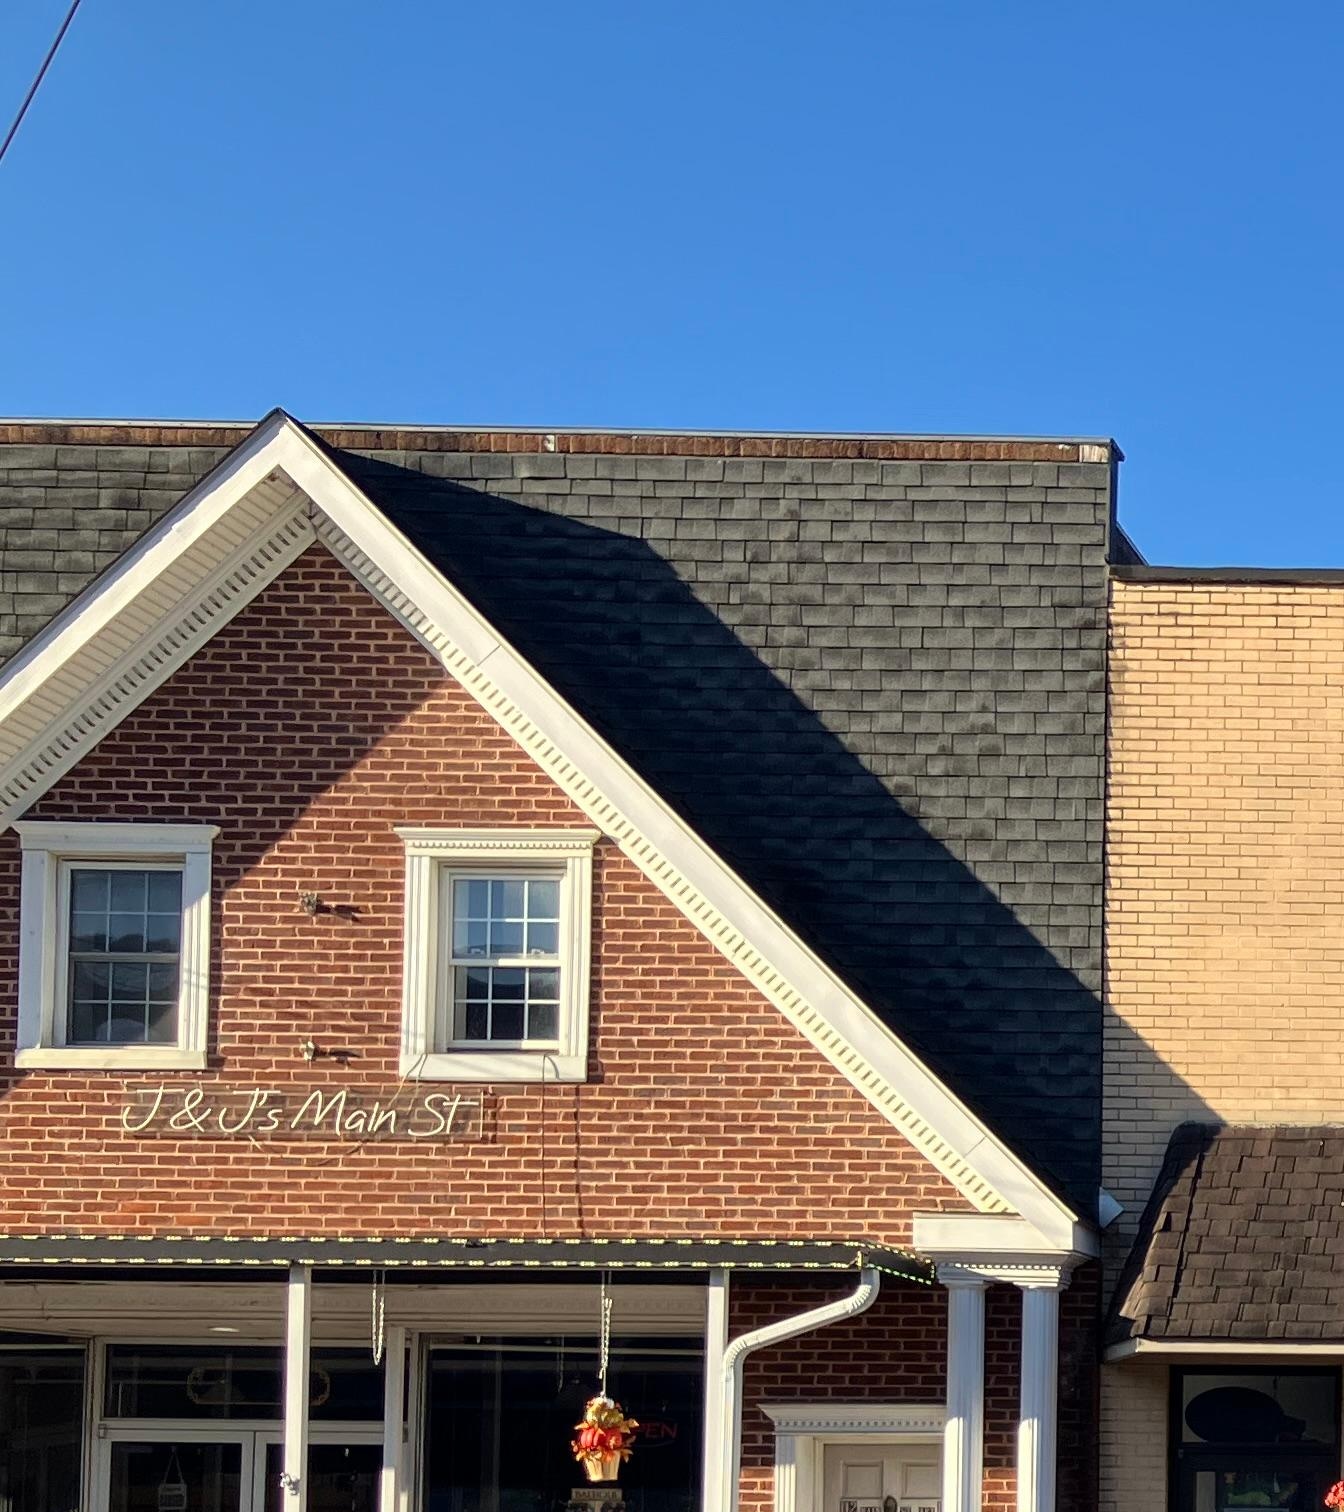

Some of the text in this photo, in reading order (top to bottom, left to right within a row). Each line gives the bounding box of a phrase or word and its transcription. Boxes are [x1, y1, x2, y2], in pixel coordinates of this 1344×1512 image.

[122, 1085, 478, 1138] J & J's Main St
